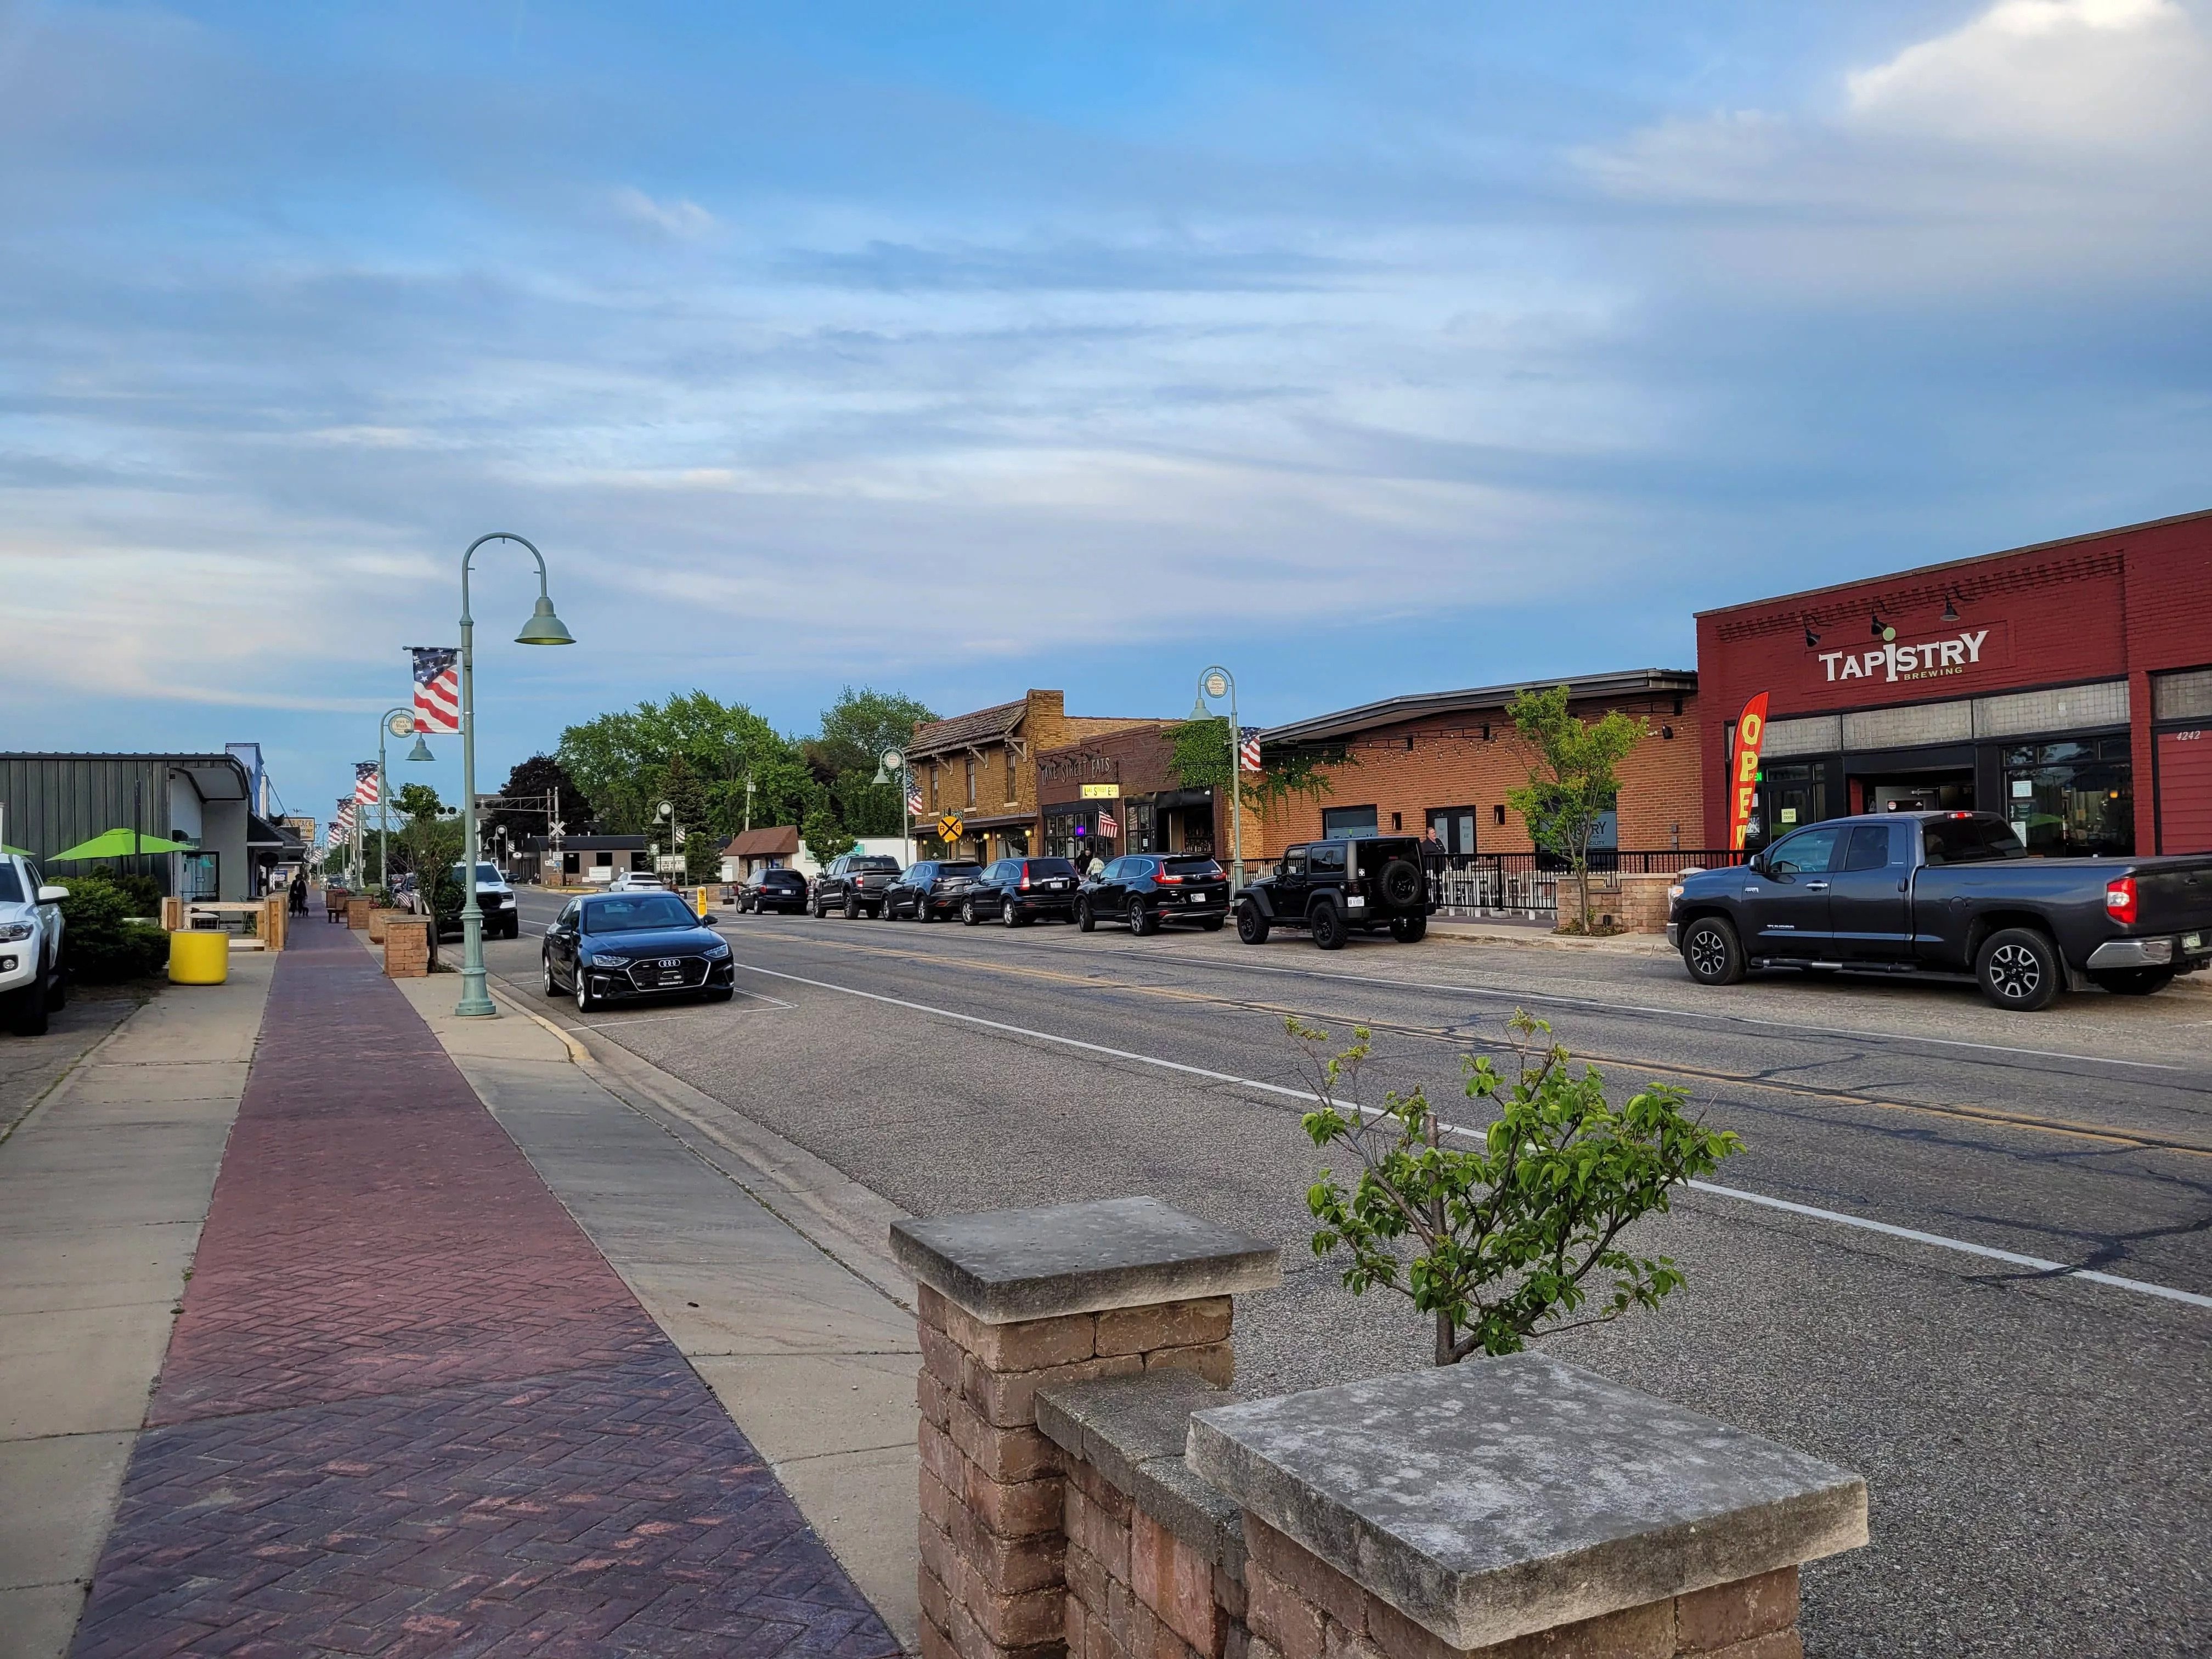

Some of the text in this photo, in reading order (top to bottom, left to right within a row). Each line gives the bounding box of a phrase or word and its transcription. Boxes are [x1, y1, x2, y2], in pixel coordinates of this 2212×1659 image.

[1904, 667, 1963, 680] BREWING
[2176, 731, 2200, 741] 4242
[1062, 761, 1087, 783] STREET
[1092, 758, 1110, 778] EATS
